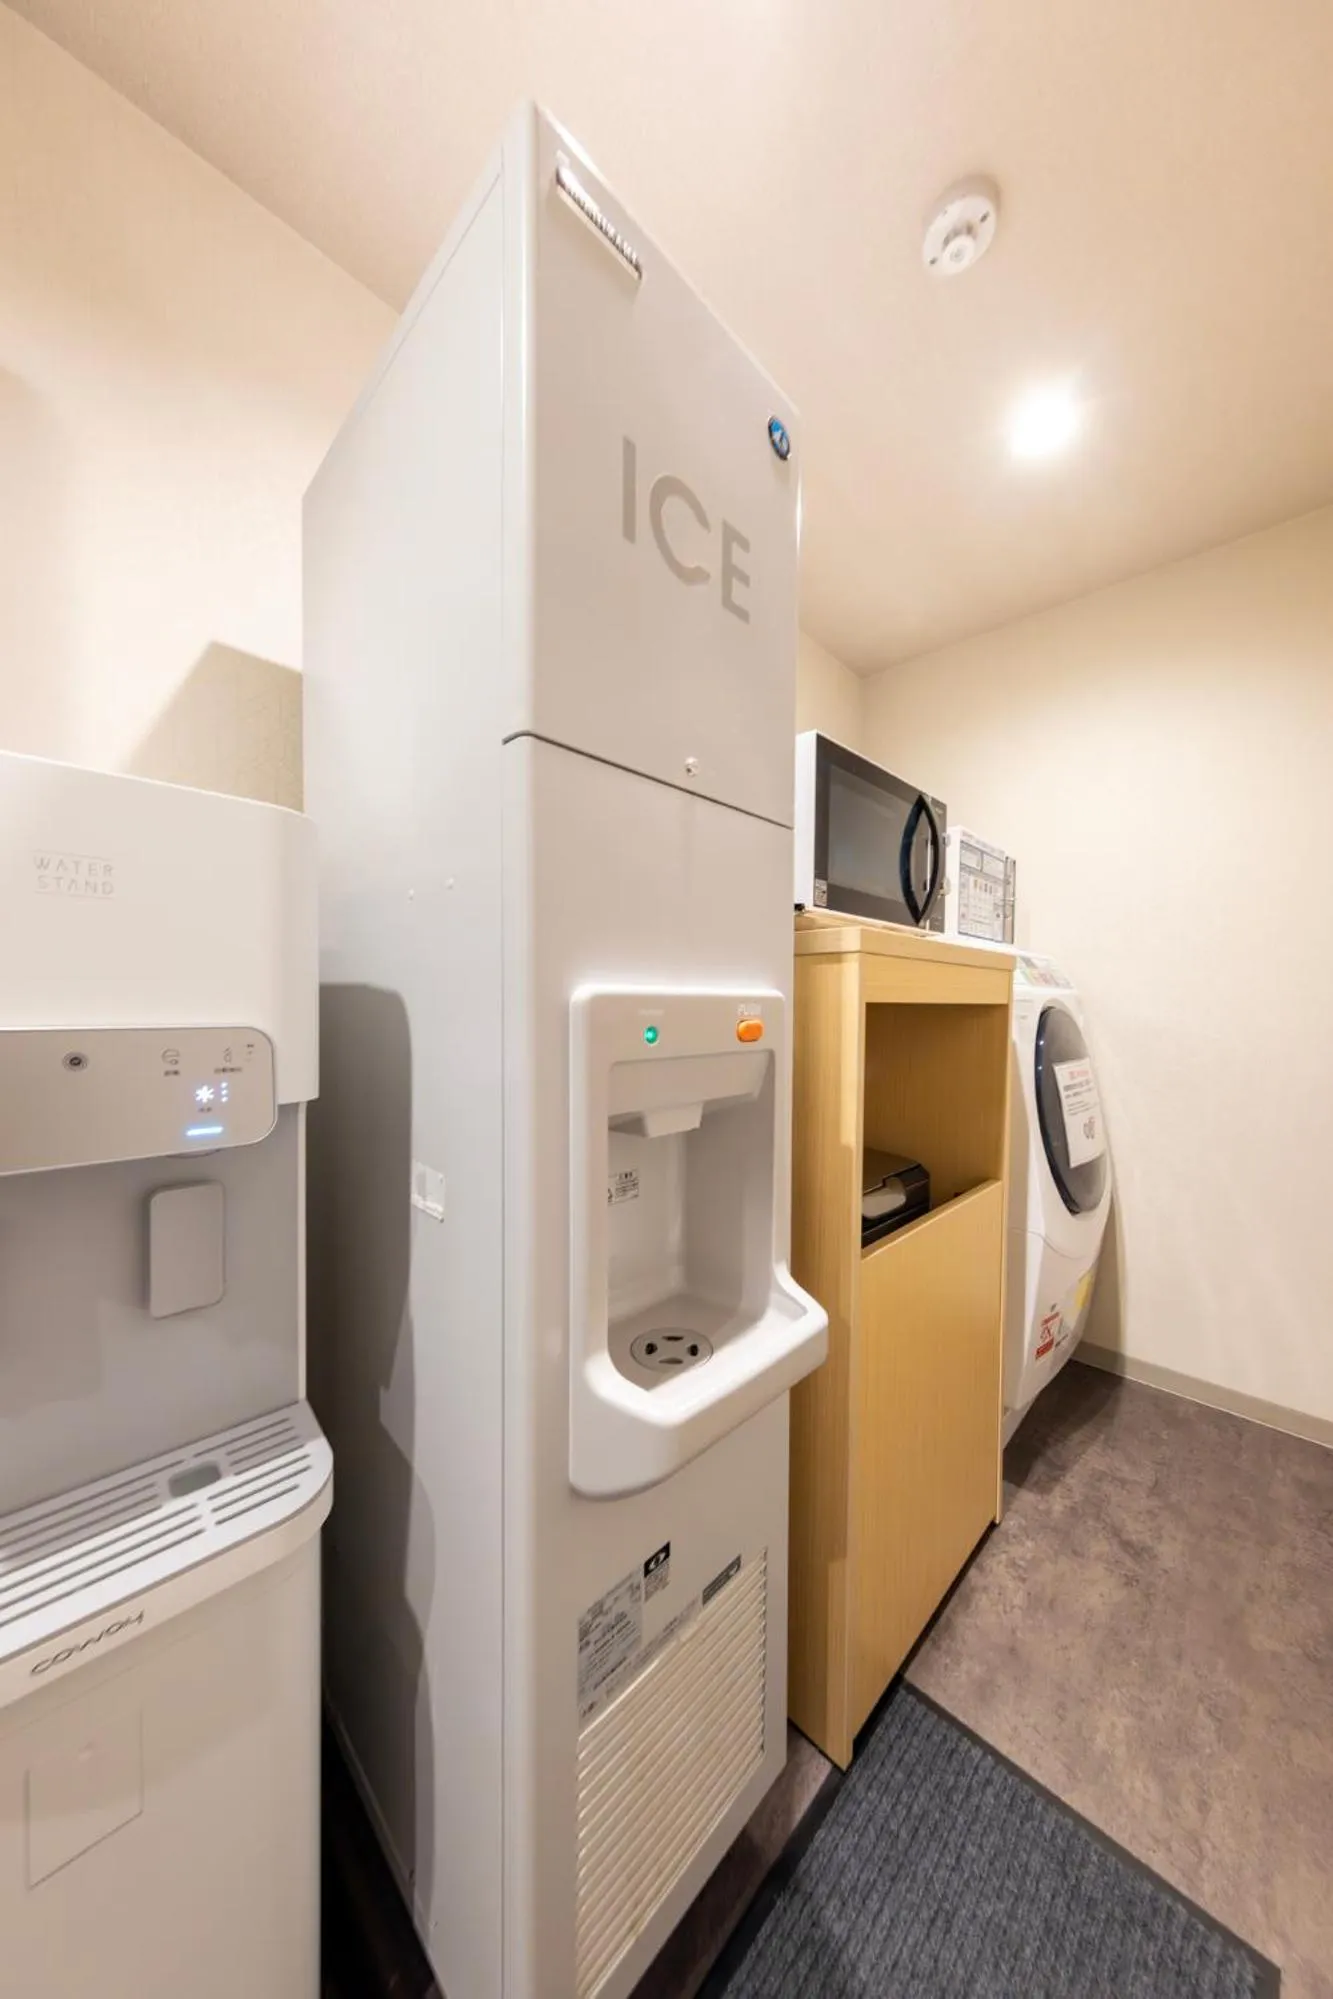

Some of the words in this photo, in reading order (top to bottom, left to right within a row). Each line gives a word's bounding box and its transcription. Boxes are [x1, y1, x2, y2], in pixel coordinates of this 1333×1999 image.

[622, 434, 750, 625] ICE
[33, 856, 114, 877] WATER
[37, 874, 114, 896] STAND
